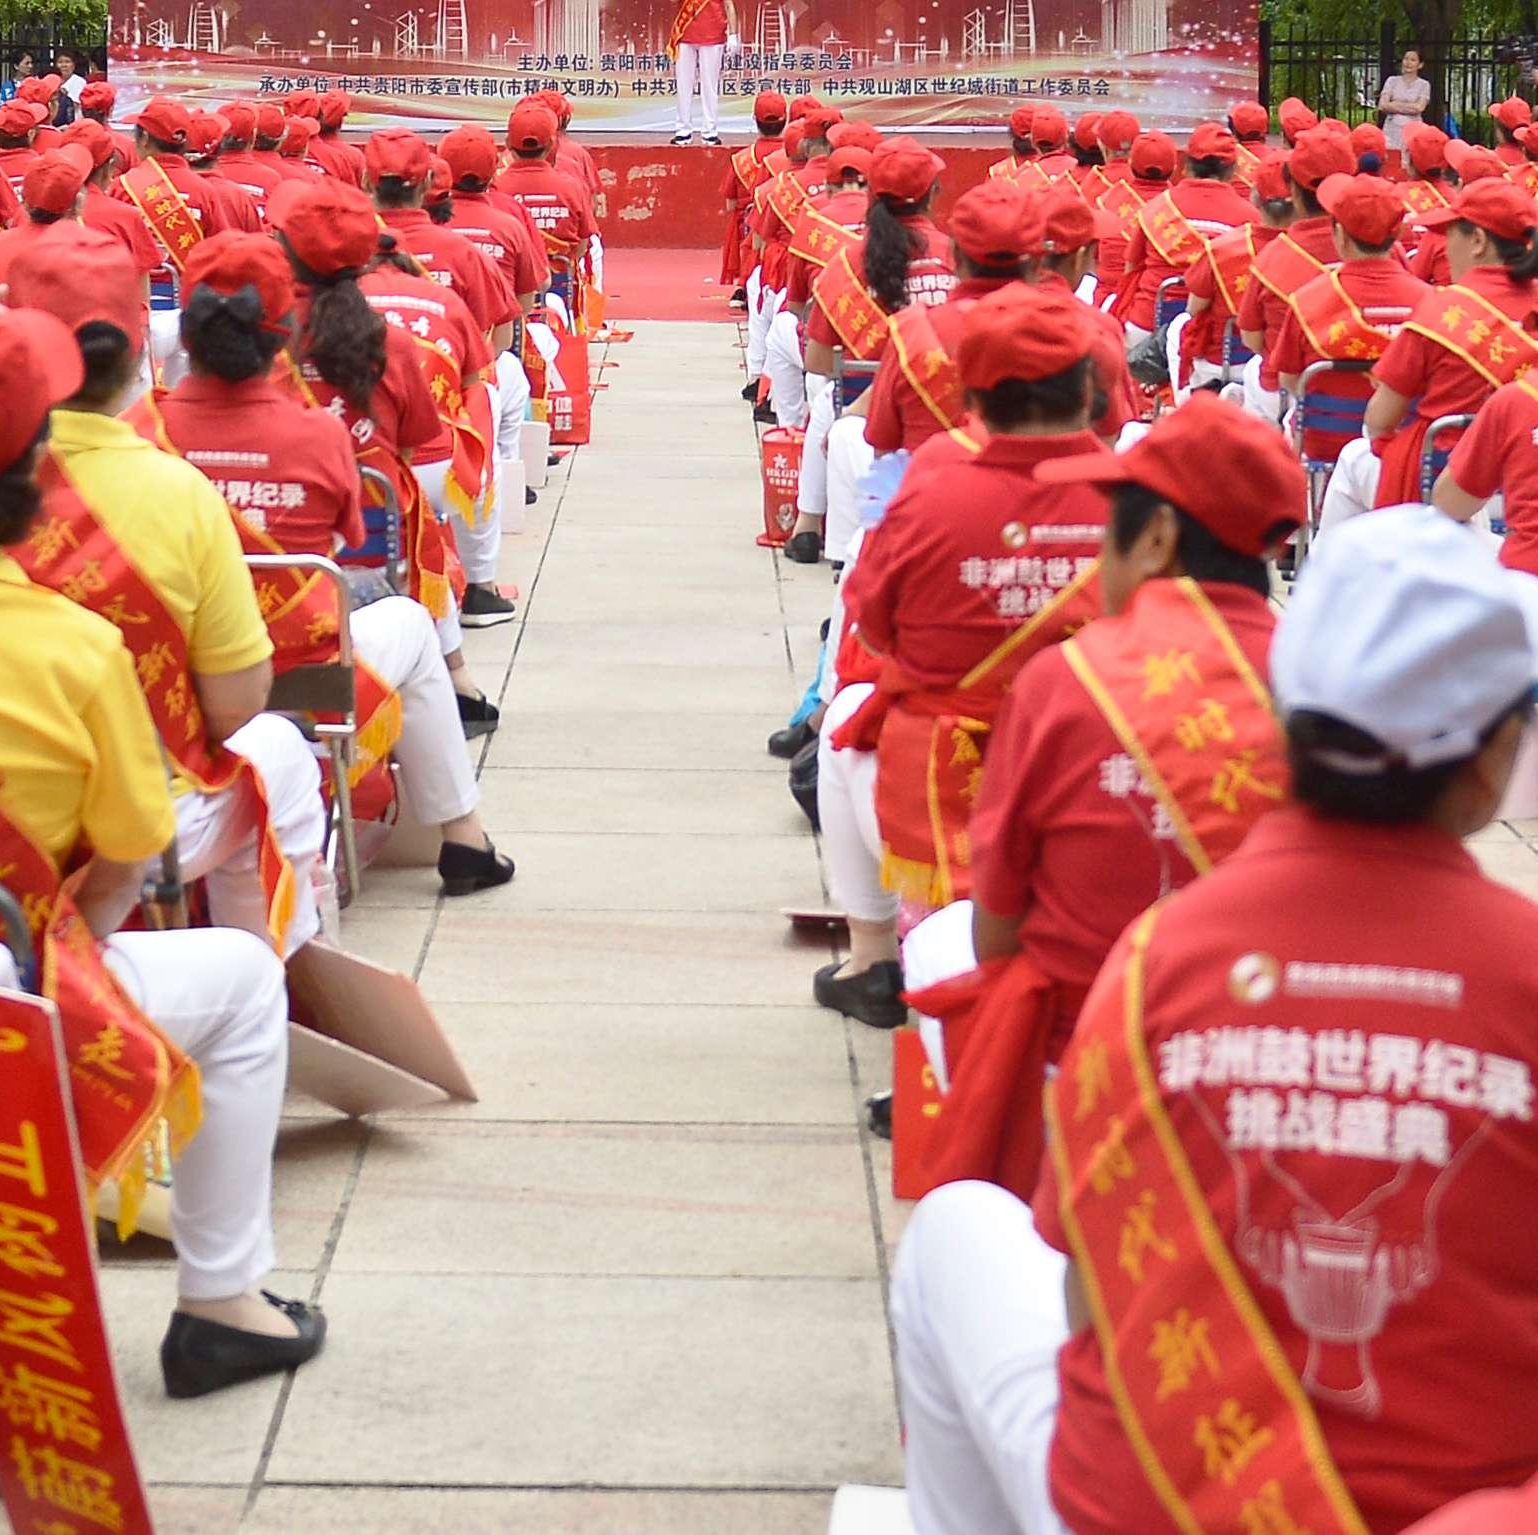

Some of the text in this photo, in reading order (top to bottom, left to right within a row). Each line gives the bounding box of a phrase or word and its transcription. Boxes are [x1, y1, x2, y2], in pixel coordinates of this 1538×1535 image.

[1159, 1024, 1536, 1122] 非洲鼓世界纪录
[1225, 1086, 1453, 1168] 挑战盛典
